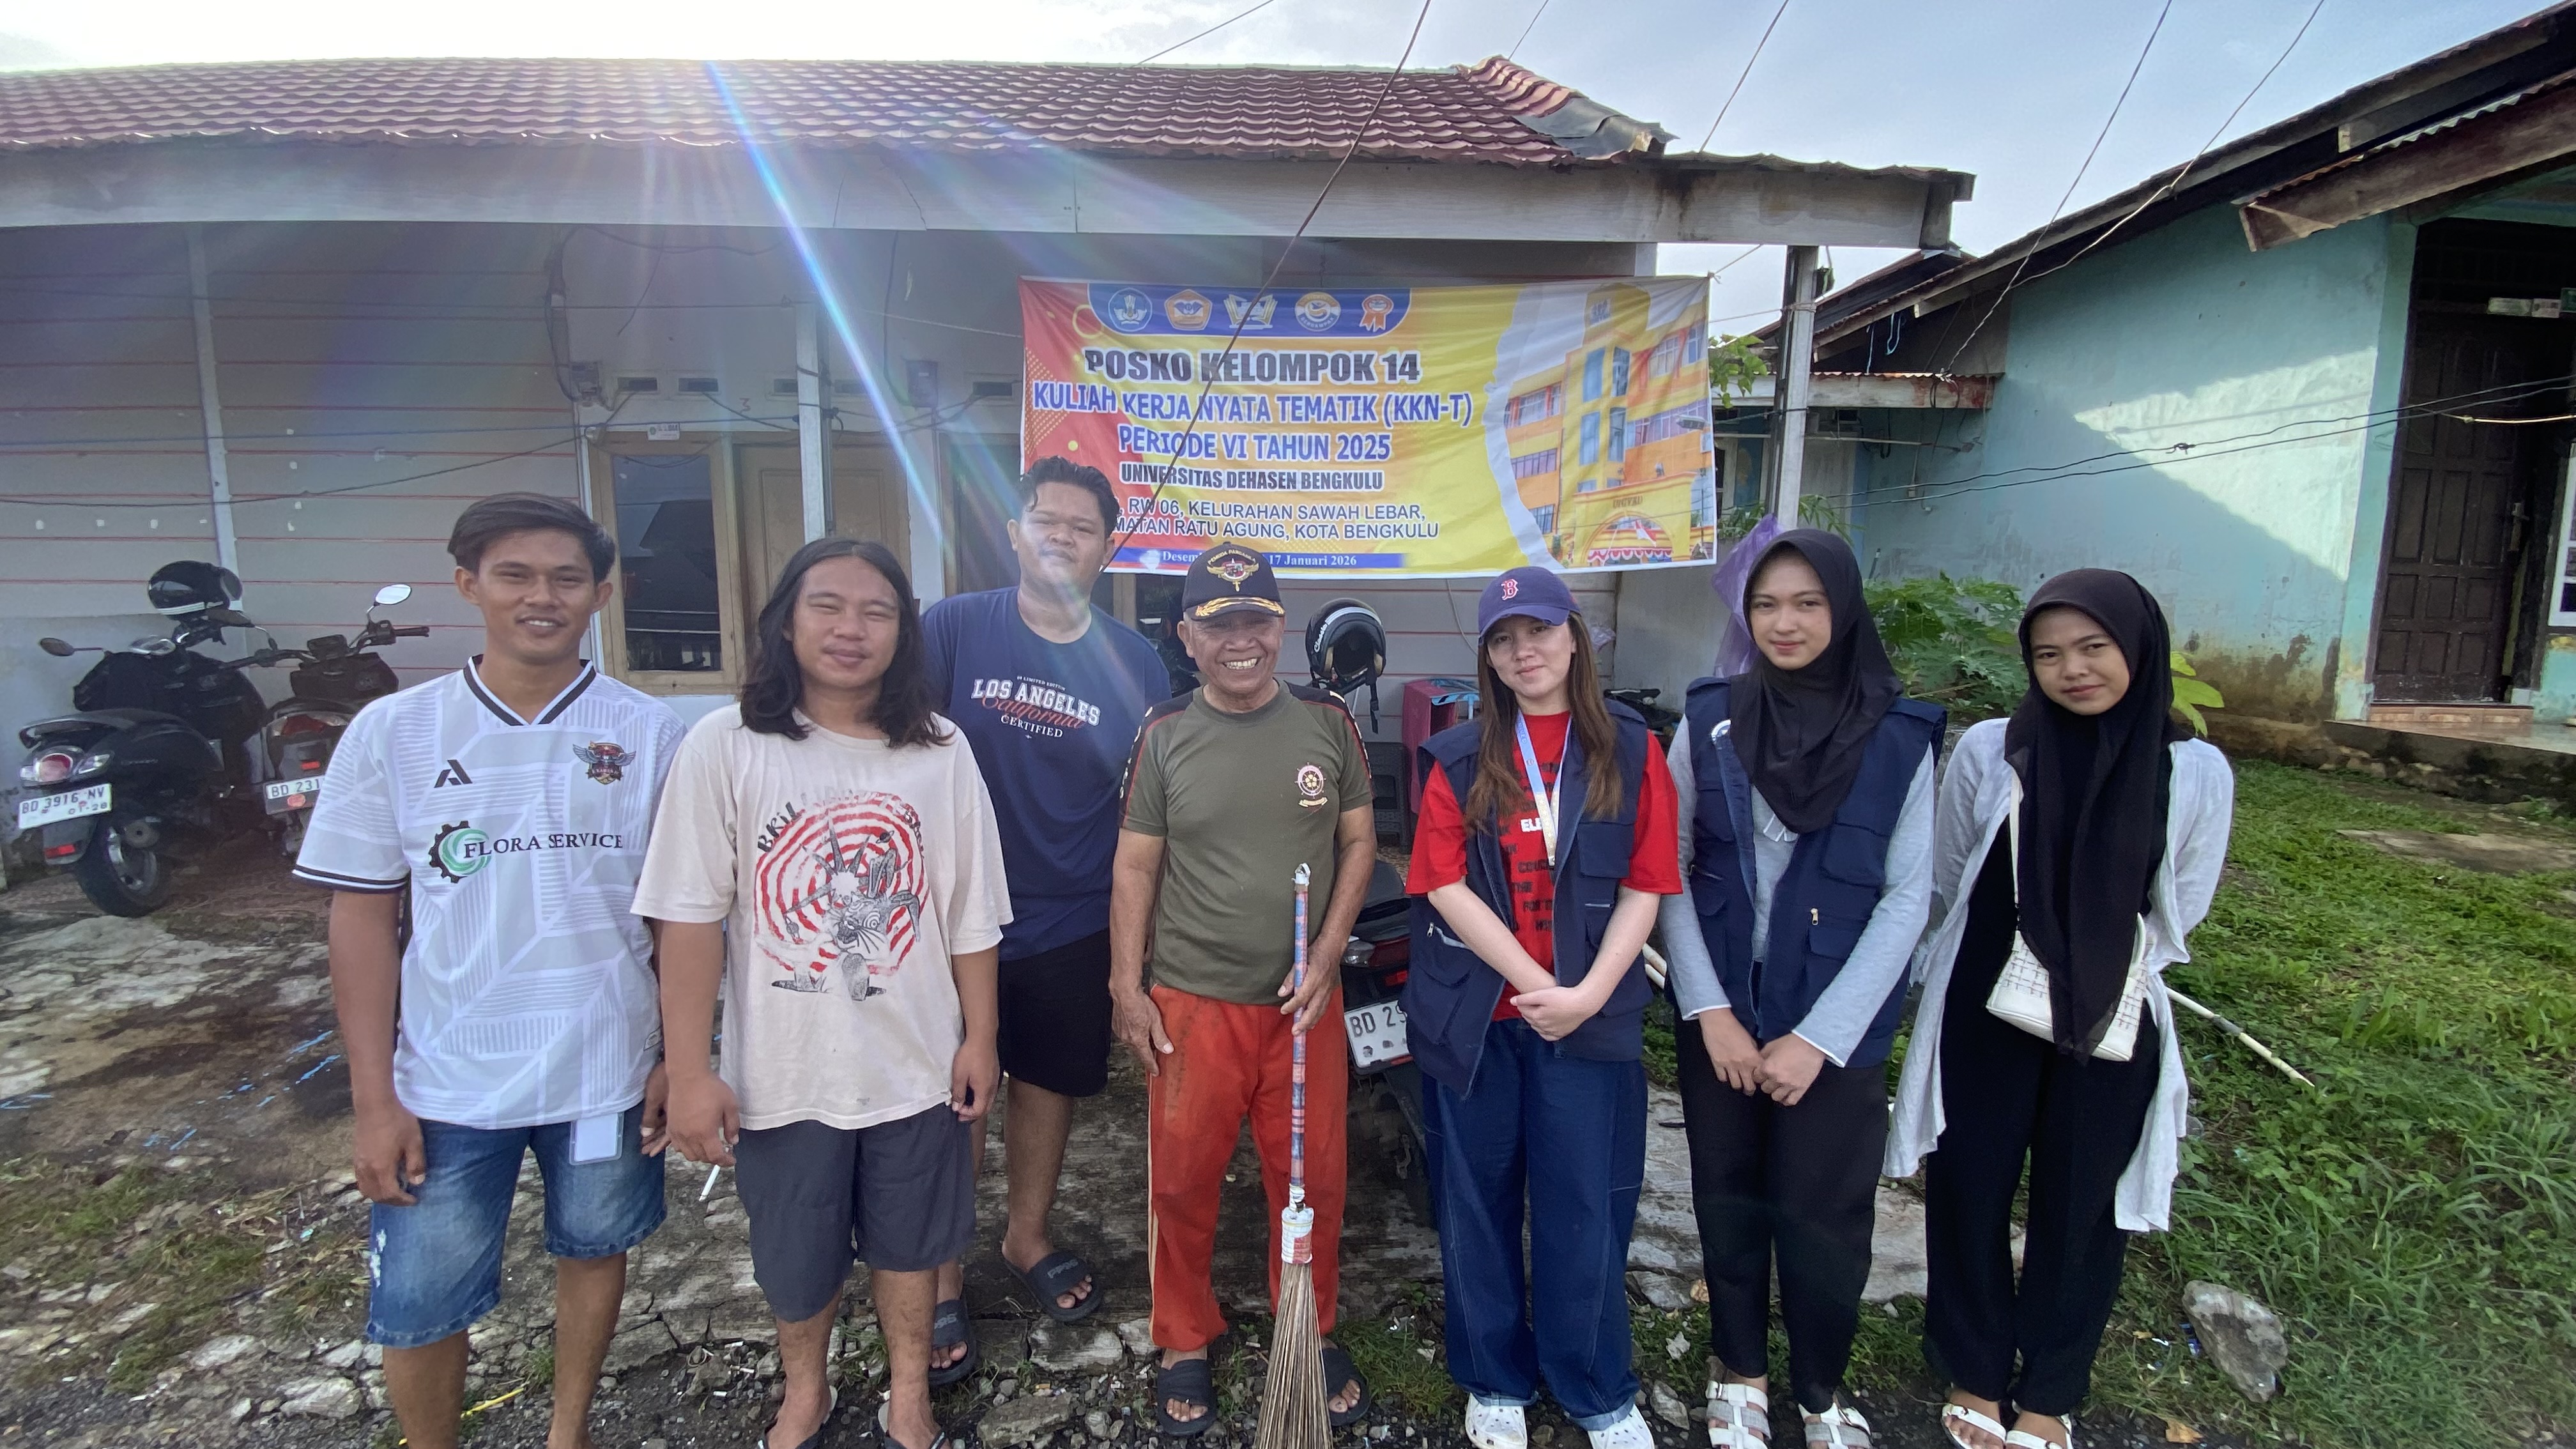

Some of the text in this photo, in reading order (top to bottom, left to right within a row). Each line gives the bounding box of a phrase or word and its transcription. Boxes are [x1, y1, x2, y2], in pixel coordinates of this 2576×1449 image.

[1084, 349, 1420, 382] POSKO KELOMPOK 14
[1034, 382, 1472, 427] KULIAH KERJA NYATA TEMATIK (KKN-T)
[1120, 425, 1391, 461] PERIODE VI TAHUN 2025
[1121, 463, 1384, 489] UNIVERSITAS DEHASEN BENGKULU
[1129, 498, 1425, 521] RW 06, KELURAHAN SAWAH LEBAR,
[1116, 516, 1439, 540] MATAN RATU AGUNG, KOTA BENGKULU
[1163, 551, 1356, 565] Desem 17 Januari 2026
[1501, 578, 1518, 601] B
[970, 678, 1101, 726] LOS ANGELES
[1000, 714, 1064, 738] CERTIFIED
[22, 786, 105, 814] BD 3916 NV
[272, 779, 319, 797] BD 231
[463, 832, 623, 859] FLORA SERVICE
[1349, 1006, 1407, 1038] BD 29
